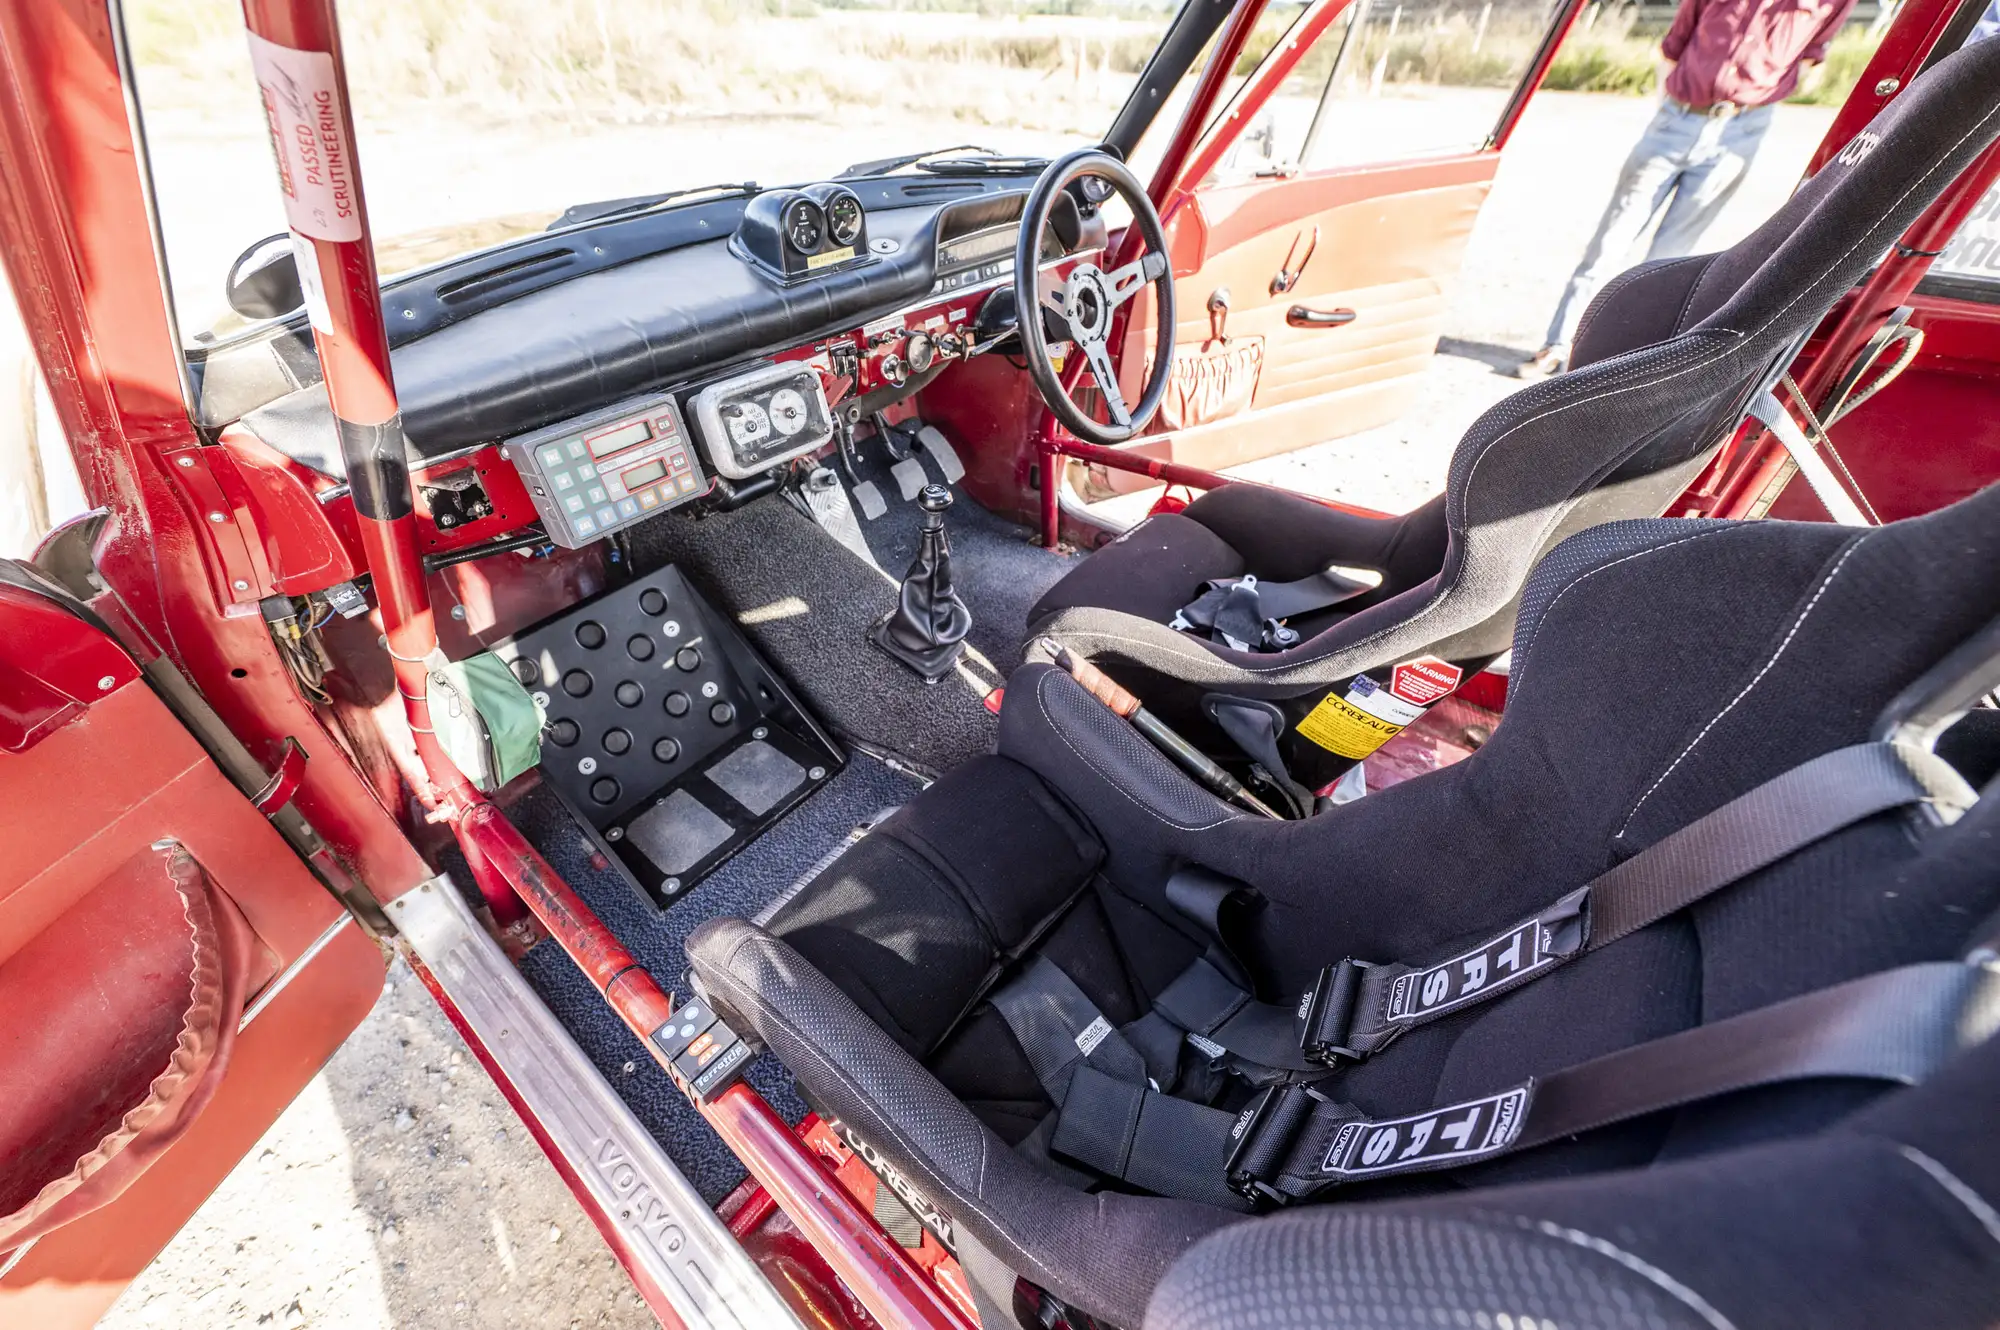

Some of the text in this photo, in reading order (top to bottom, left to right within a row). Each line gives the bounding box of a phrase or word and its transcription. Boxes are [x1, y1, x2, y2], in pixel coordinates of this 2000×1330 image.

[295, 124, 323, 186] PASSED
[313, 90, 352, 219] SCRUTINEERING
[1412, 662, 1456, 685] WARNING
[1326, 697, 1386, 731] CORBEAU
[1422, 932, 1522, 1006] TRS
[1298, 991, 1312, 1020] TRS
[1392, 977, 1406, 1014] TRS
[1078, 1023, 1104, 1050] TRS
[696, 1046, 743, 1087] Terratrip
[1232, 1108, 1254, 1140] TRS
[1362, 1107, 1482, 1166] TRS
[1492, 1096, 1518, 1144] TRS
[1330, 1125, 1354, 1167] TRS
[597, 1138, 687, 1258] VOLVO
[846, 1127, 957, 1252] CORBEAU
